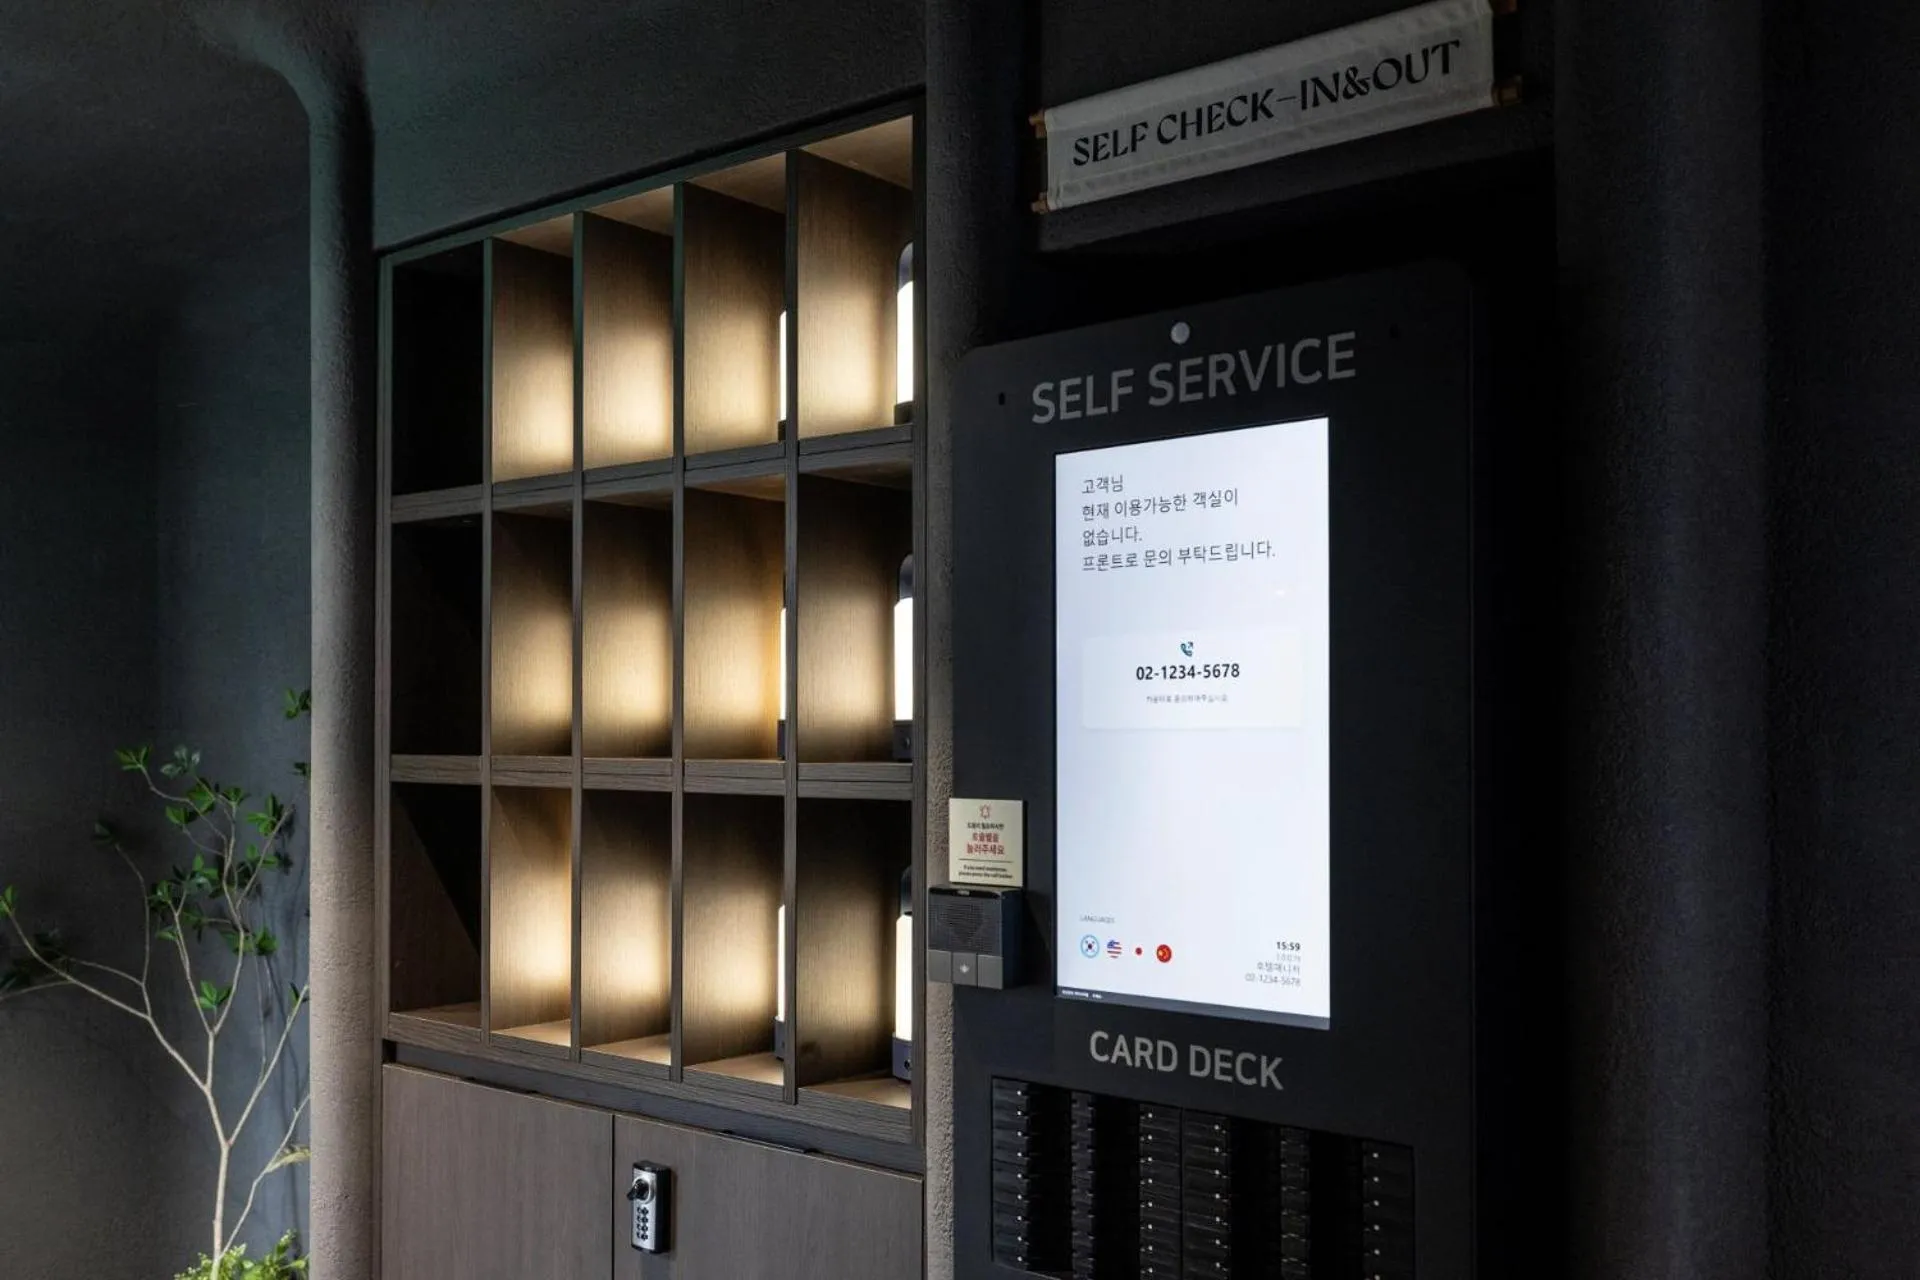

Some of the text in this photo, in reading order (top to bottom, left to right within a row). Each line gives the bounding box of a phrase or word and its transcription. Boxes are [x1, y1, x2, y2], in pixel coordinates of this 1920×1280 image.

[1074, 122, 1149, 167] SELF
[1031, 330, 1356, 425] SELF SERVICE
[1082, 474, 1124, 495] 고객님
[1082, 487, 1239, 520] 현재 이용가능한 객실이
[1082, 524, 1144, 547] 없습니다.
[1082, 539, 1276, 572] 프론트로 문의 부탁드립니다.
[1135, 663, 1241, 681] 02-1234-5678
[1276, 941, 1301, 951] 15:59
[1089, 1030, 1284, 1091] CARD DECK
